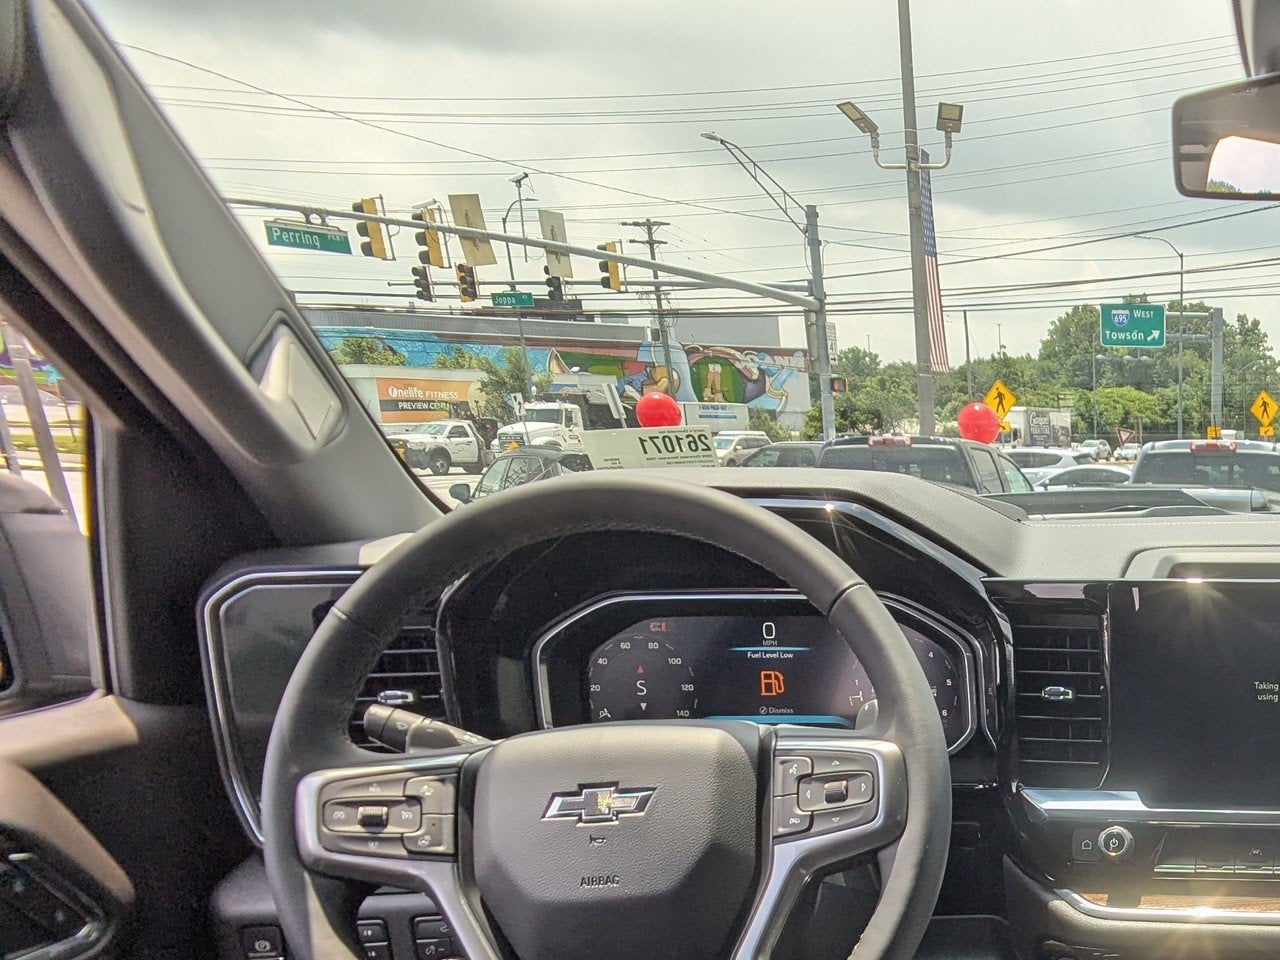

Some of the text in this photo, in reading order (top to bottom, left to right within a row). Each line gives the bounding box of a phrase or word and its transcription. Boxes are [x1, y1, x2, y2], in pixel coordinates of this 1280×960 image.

[271, 227, 320, 249] Perring
[494, 296, 516, 305] Joppa
[1114, 314, 1127, 323] 695
[425, 390, 459, 399] FITNESS
[398, 402, 428, 410] PREVIEW
[762, 621, 776, 639] 0
[747, 651, 761, 659] Fuel
[762, 651, 779, 659] Level
[668, 657, 682, 665] 100
[590, 684, 601, 692] 20
[636, 680, 647, 695] S
[1254, 681, 1279, 691] Taking
[1257, 693, 1278, 702] using
[580, 874, 620, 888] AIRBAG
